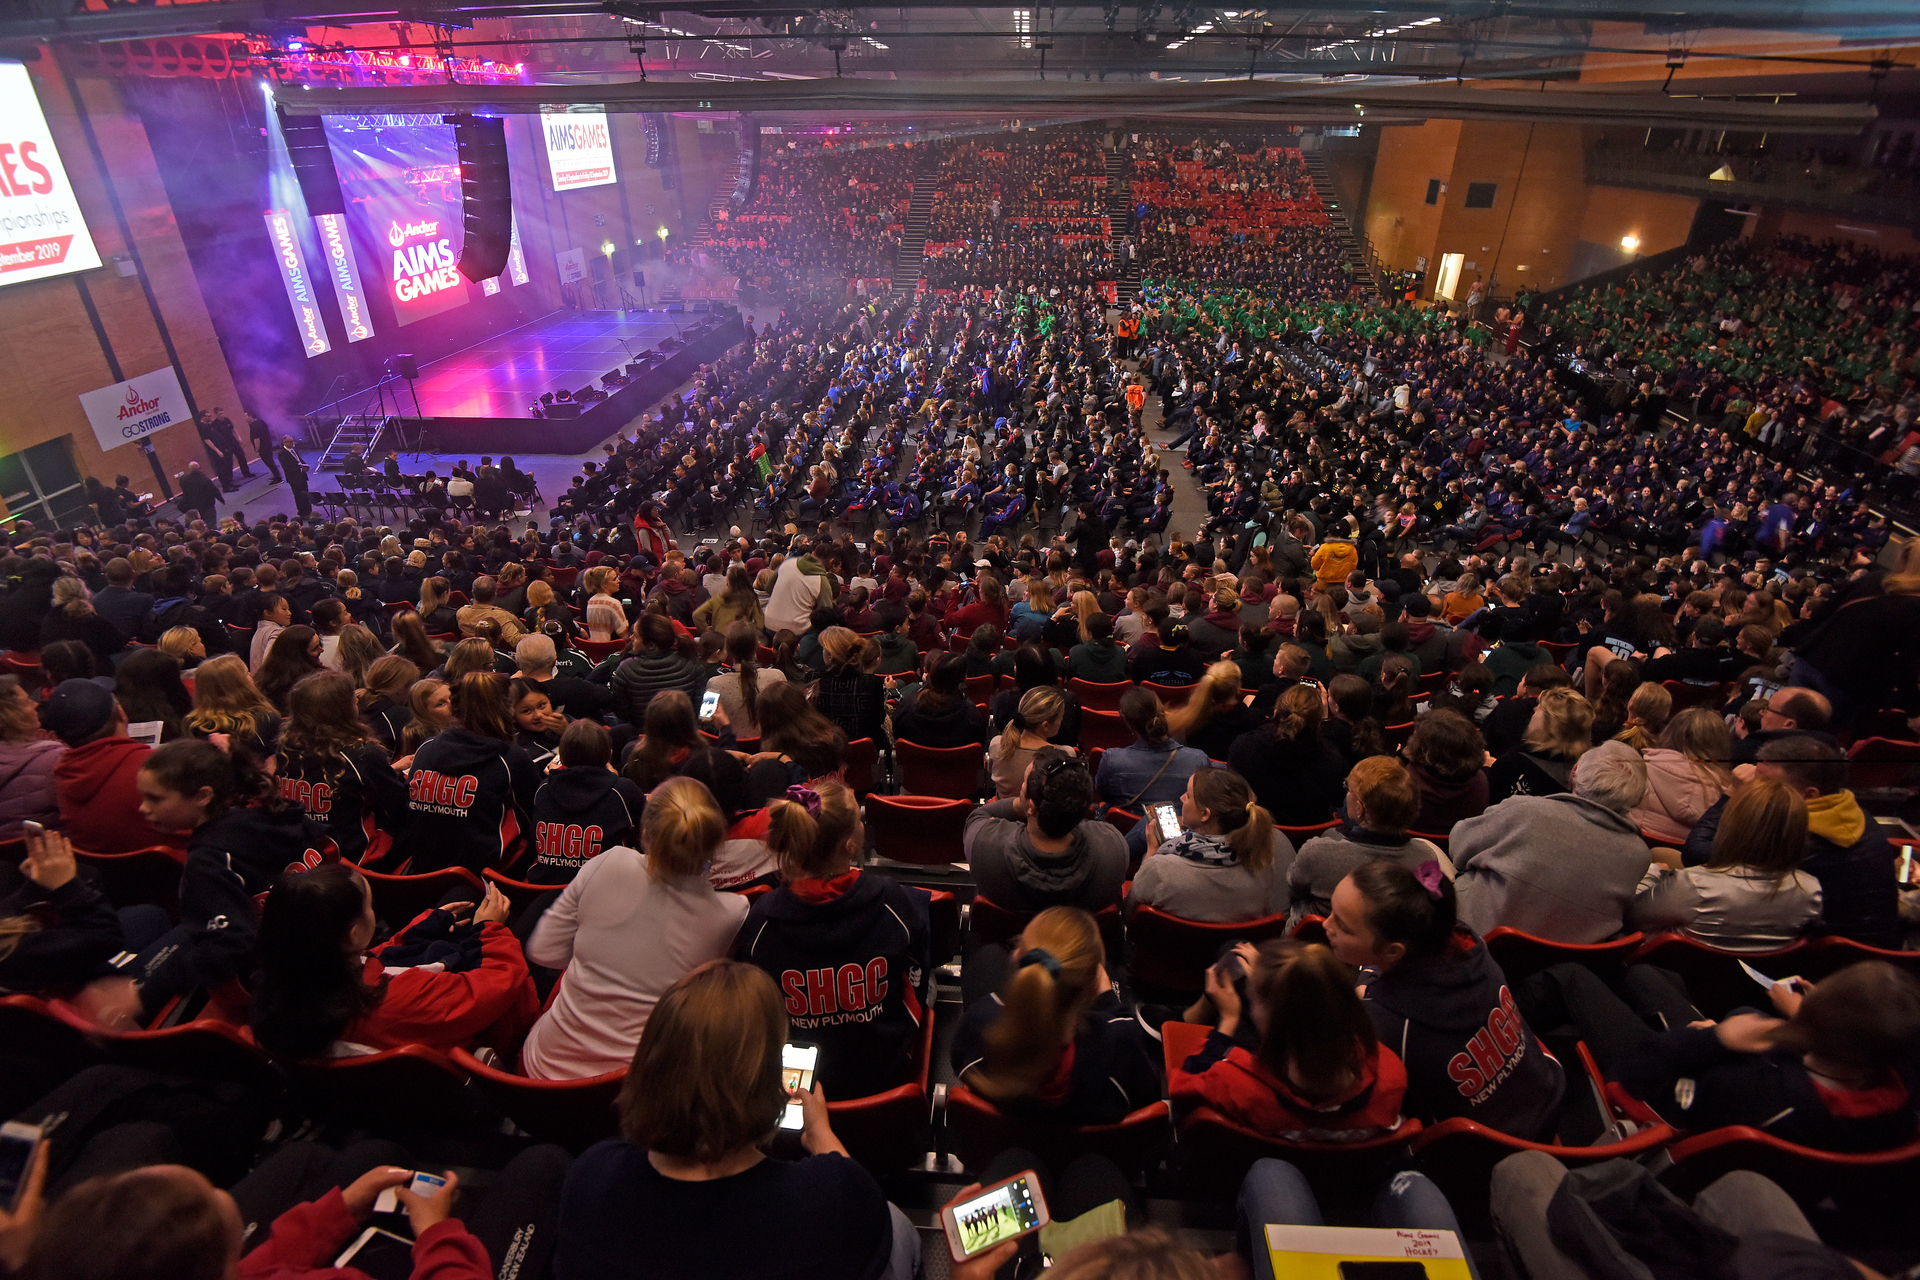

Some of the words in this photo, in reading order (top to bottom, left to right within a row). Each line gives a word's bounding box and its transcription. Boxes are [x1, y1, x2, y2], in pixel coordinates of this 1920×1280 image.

[549, 124, 607, 151] AIMSGAMES
[0, 140, 53, 198] ES
[0, 203, 69, 238] pionships
[404, 220, 440, 238] Anchor
[35, 242, 61, 260] 2019
[272, 216, 309, 303] AIMSGAMES
[393, 238, 455, 281] AIMS
[395, 265, 460, 302] GAMES
[301, 304, 319, 340] Anchor
[345, 292, 360, 327] Anchor
[116, 397, 160, 421] Anchor
[275, 773, 332, 814] HGC
[409, 769, 479, 808] SHGC
[424, 804, 468, 818] PLYMOUTH
[536, 821, 603, 860] SHGC
[781, 956, 889, 1016] SHGC
[791, 1016, 820, 1029] NEW
[822, 1003, 884, 1027] PLYMOUTH
[1469, 1080, 1498, 1107] NEW
[1404, 1246, 1438, 1257] HOCKEY
[1412, 1239, 1431, 1248] 2019
